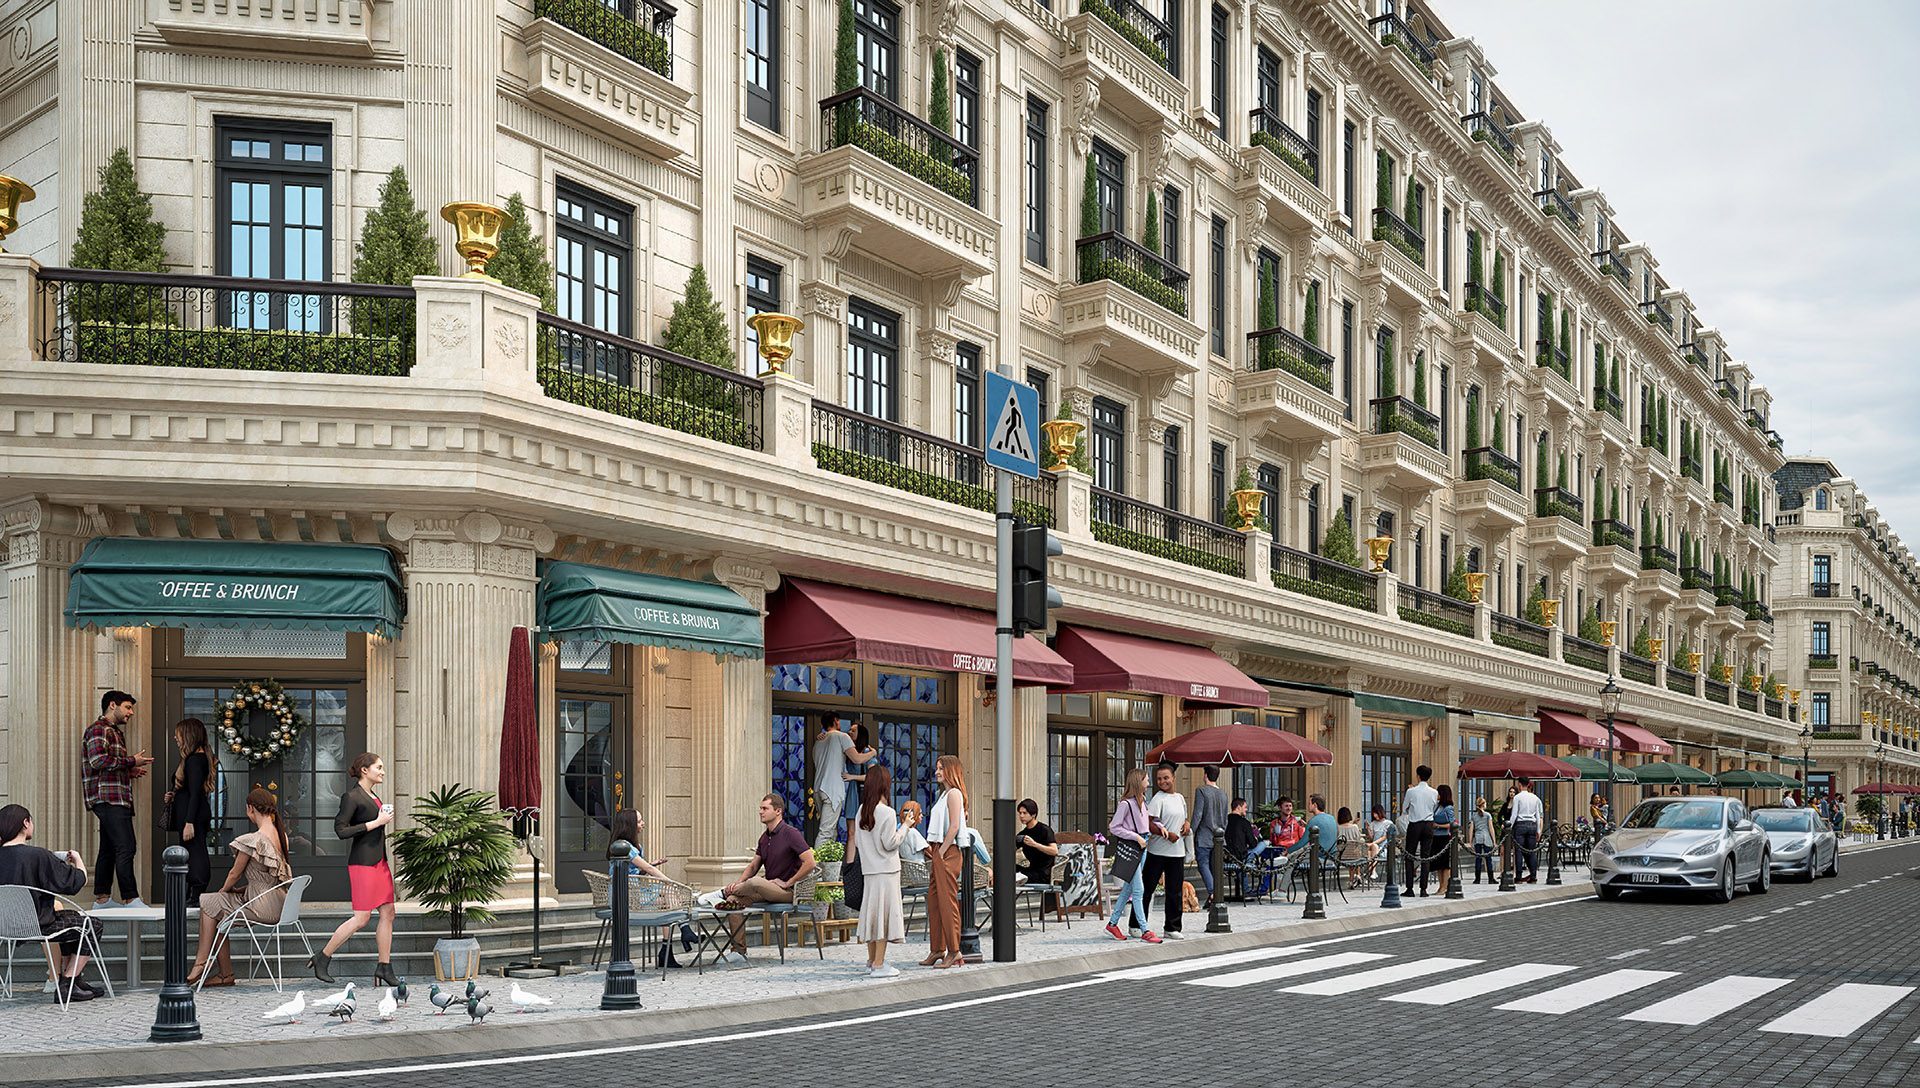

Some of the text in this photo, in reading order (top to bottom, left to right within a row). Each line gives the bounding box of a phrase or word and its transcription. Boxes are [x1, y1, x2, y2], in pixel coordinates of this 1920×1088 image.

[216, 583, 227, 599] &
[231, 583, 299, 600] BRUNCH
[634, 607, 720, 630] COFFEE & BRUNCH
[953, 654, 971, 670] COFFEE
